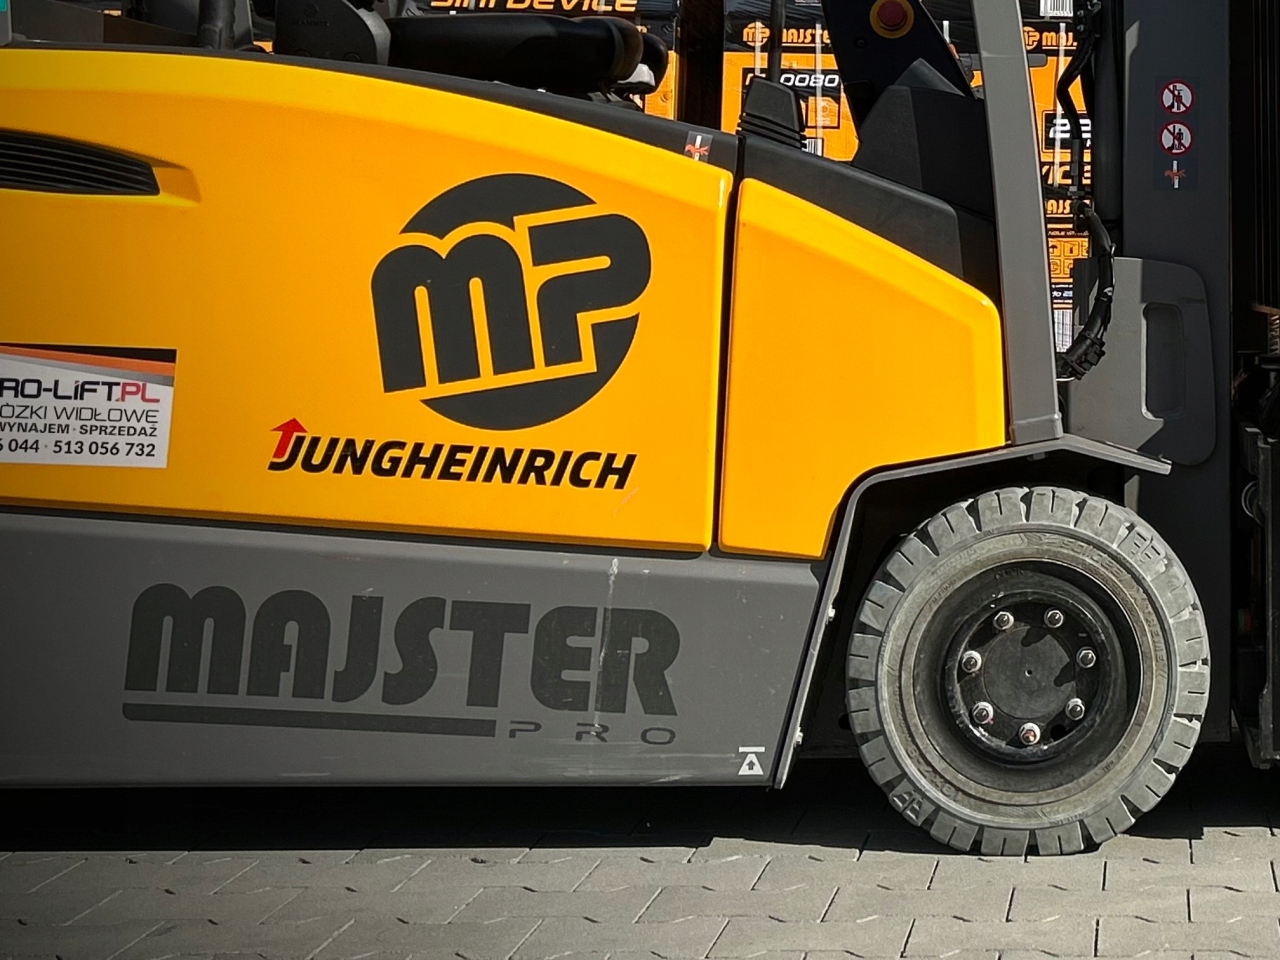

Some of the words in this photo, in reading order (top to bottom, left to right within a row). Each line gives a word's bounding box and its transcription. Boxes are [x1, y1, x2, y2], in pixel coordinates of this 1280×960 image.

[54, 406, 159, 424] WIDŁOWE
[79, 424, 157, 437] SPRZEDAŻ
[8, 439, 39, 452] 044
[53, 441, 83, 454] 513
[89, 442, 120, 455] 056
[125, 443, 155, 457] 732
[268, 426, 637, 489] JUNGHEINRICH
[124, 583, 681, 716] MAJSTER
[509, 720, 677, 745] PRO
